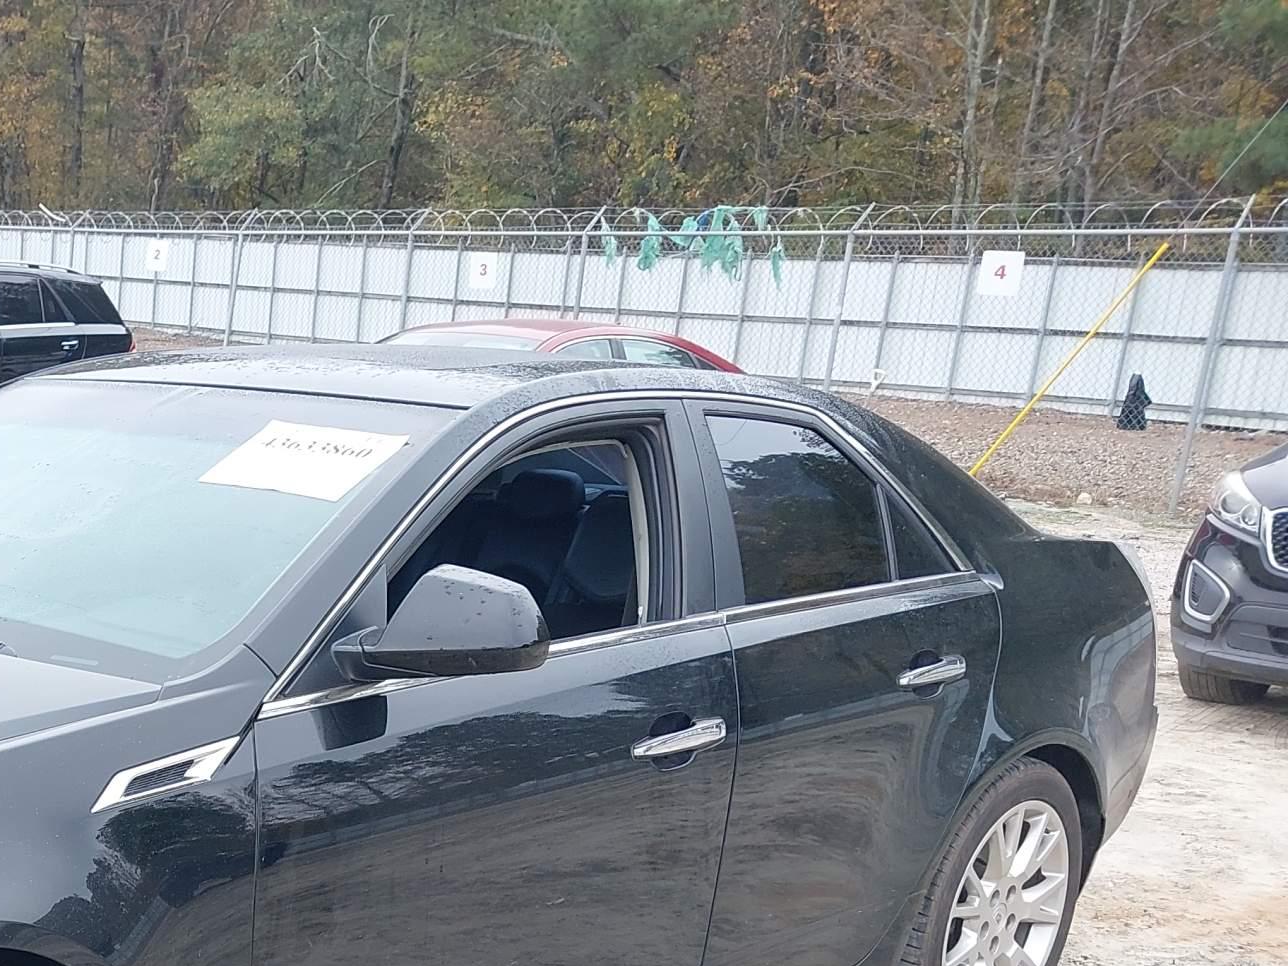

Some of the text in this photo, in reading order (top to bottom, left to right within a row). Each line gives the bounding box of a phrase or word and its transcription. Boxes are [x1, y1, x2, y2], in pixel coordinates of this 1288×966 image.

[153, 249, 161, 260] 2
[479, 263, 488, 277] 3
[994, 264, 1007, 280] 4
